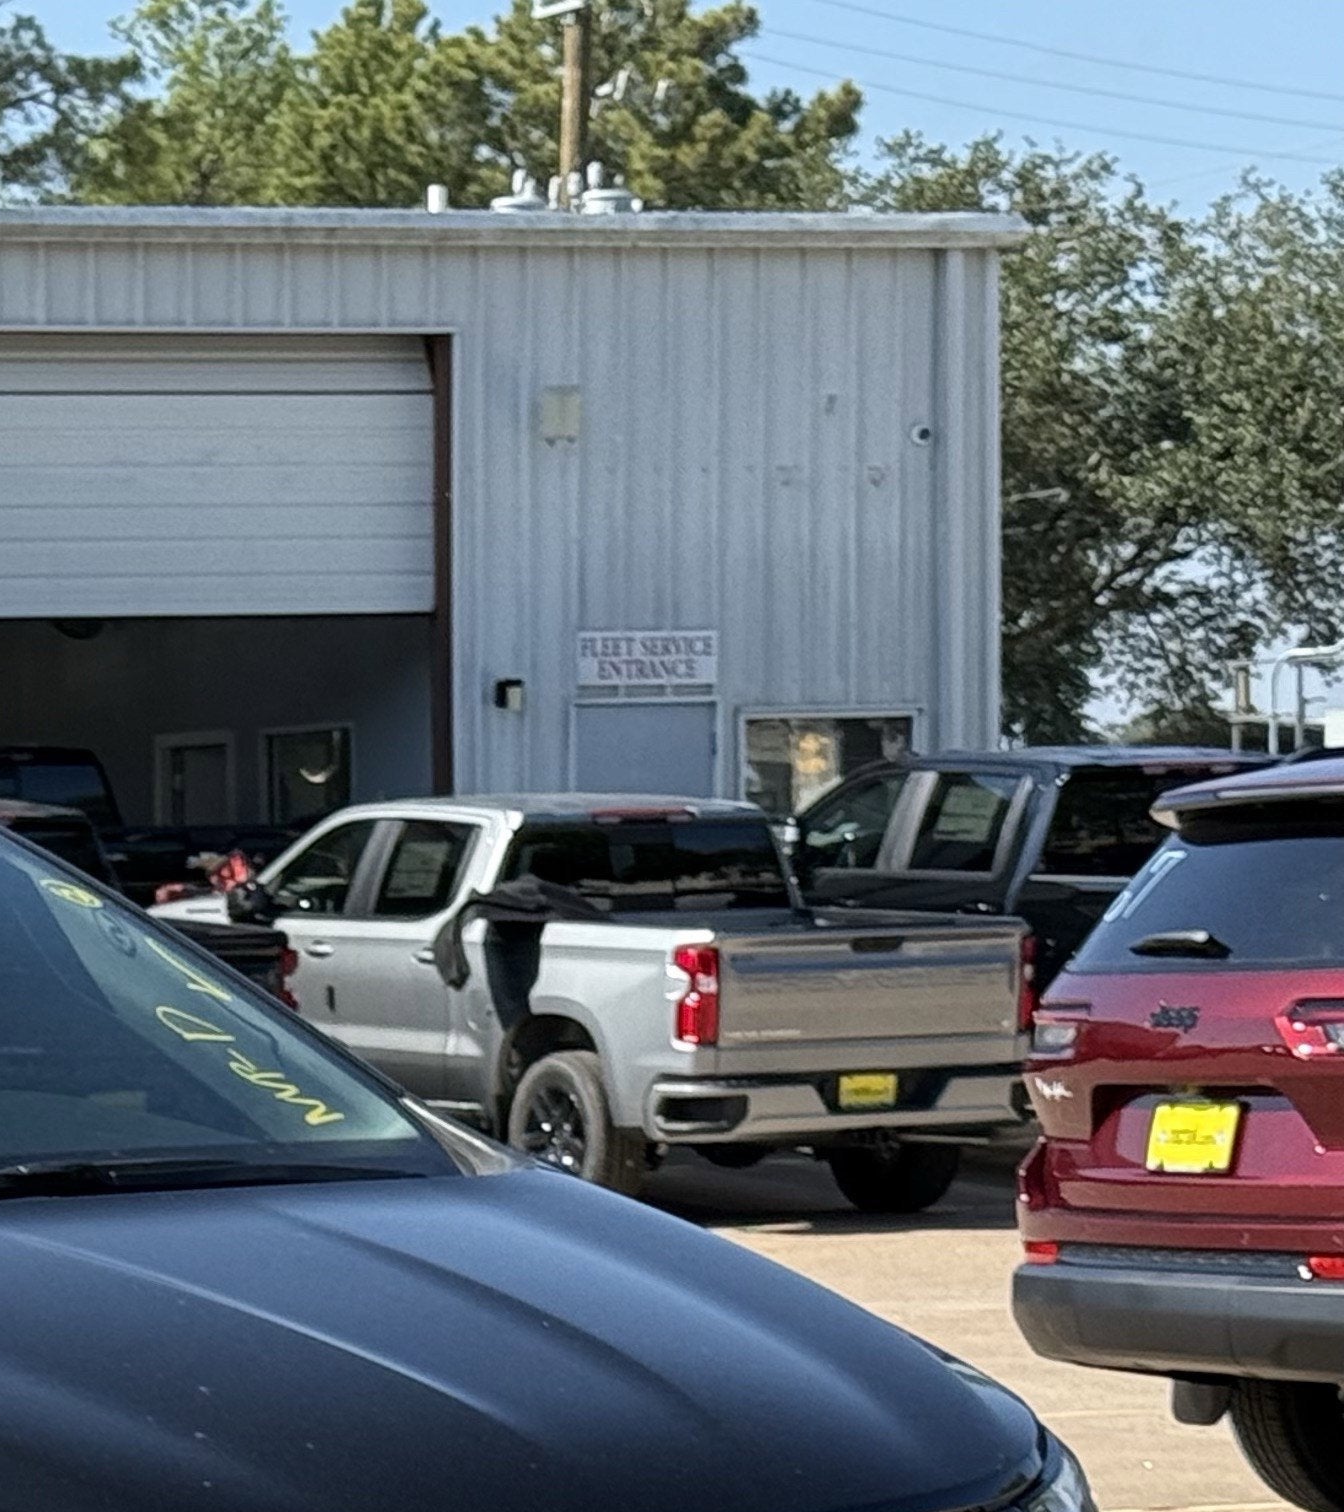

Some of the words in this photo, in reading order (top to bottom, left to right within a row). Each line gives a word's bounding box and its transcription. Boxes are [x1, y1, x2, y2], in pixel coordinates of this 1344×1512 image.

[580, 637, 636, 658] FLEET
[639, 635, 713, 657] SERVICE
[597, 658, 696, 681] ENTRANCE
